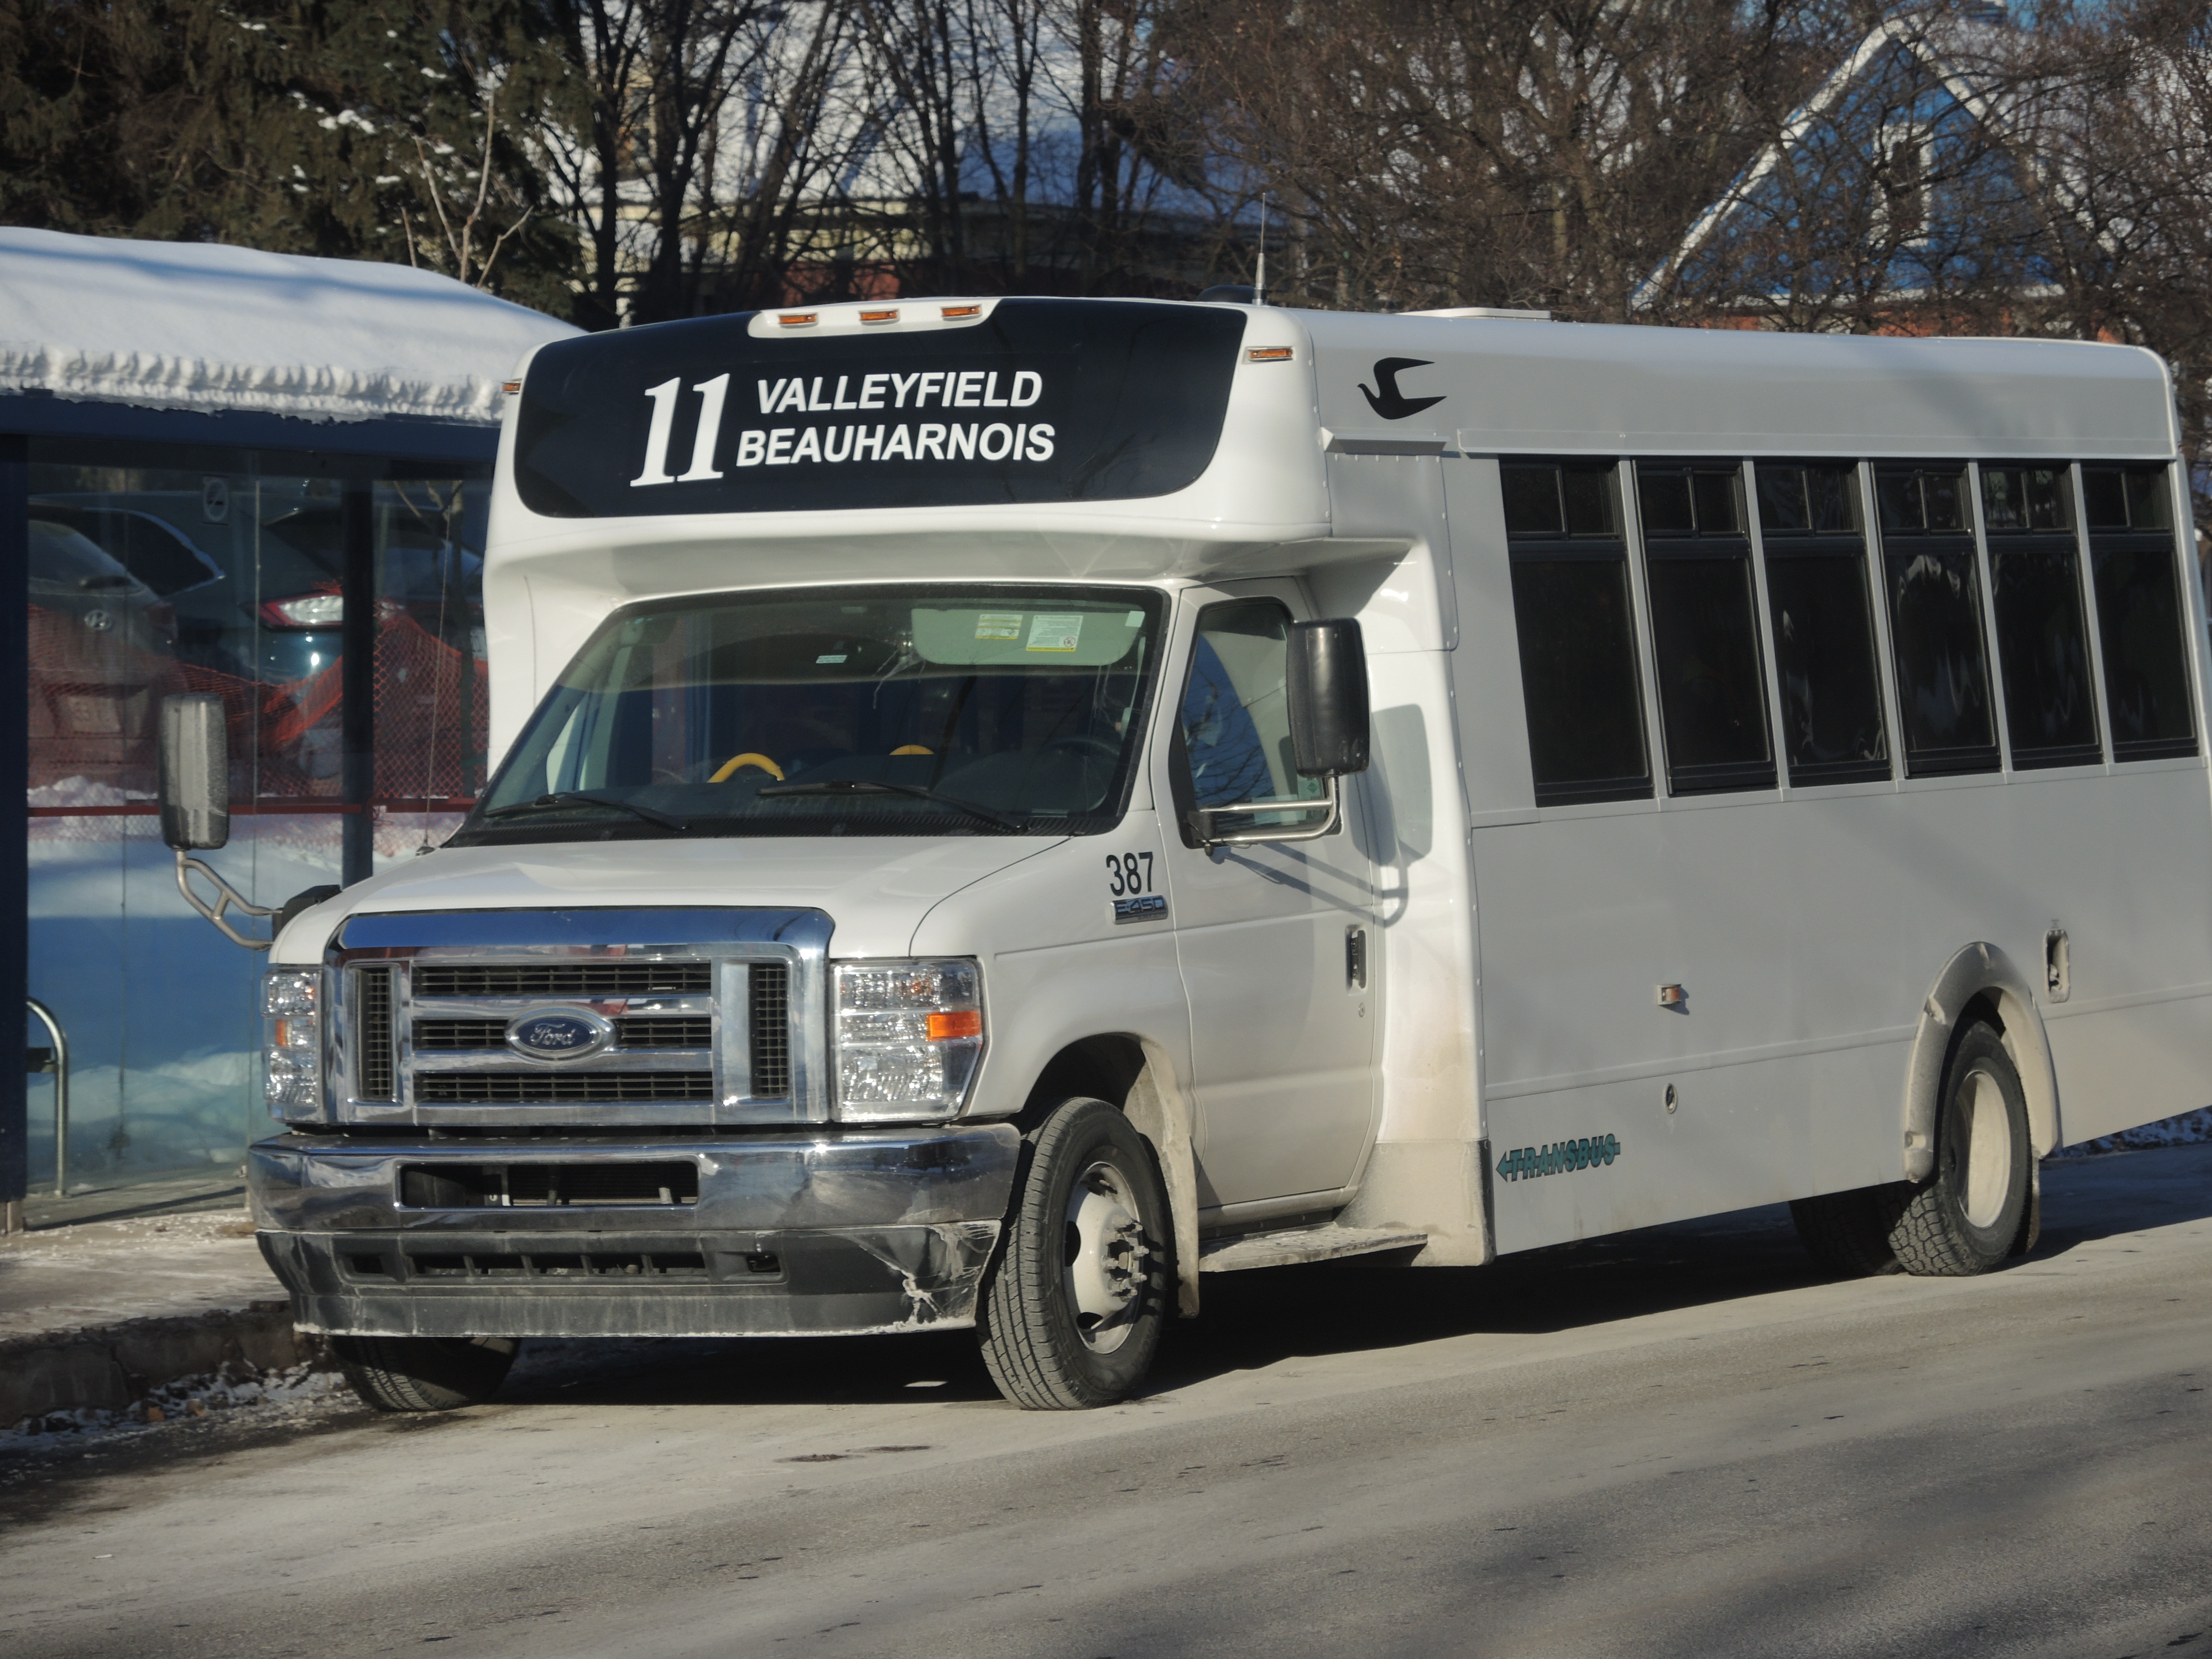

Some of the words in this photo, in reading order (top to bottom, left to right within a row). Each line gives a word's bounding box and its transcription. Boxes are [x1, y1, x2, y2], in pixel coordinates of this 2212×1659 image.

[758, 371, 1042, 414] VALLEYFIELD
[630, 373, 731, 487] 11
[736, 423, 1055, 467] BEAUHARNOIS
[1106, 852, 1154, 897] 387
[529, 1023, 576, 1045] Ford
[1509, 1133, 1616, 1182] TRANSBUS
